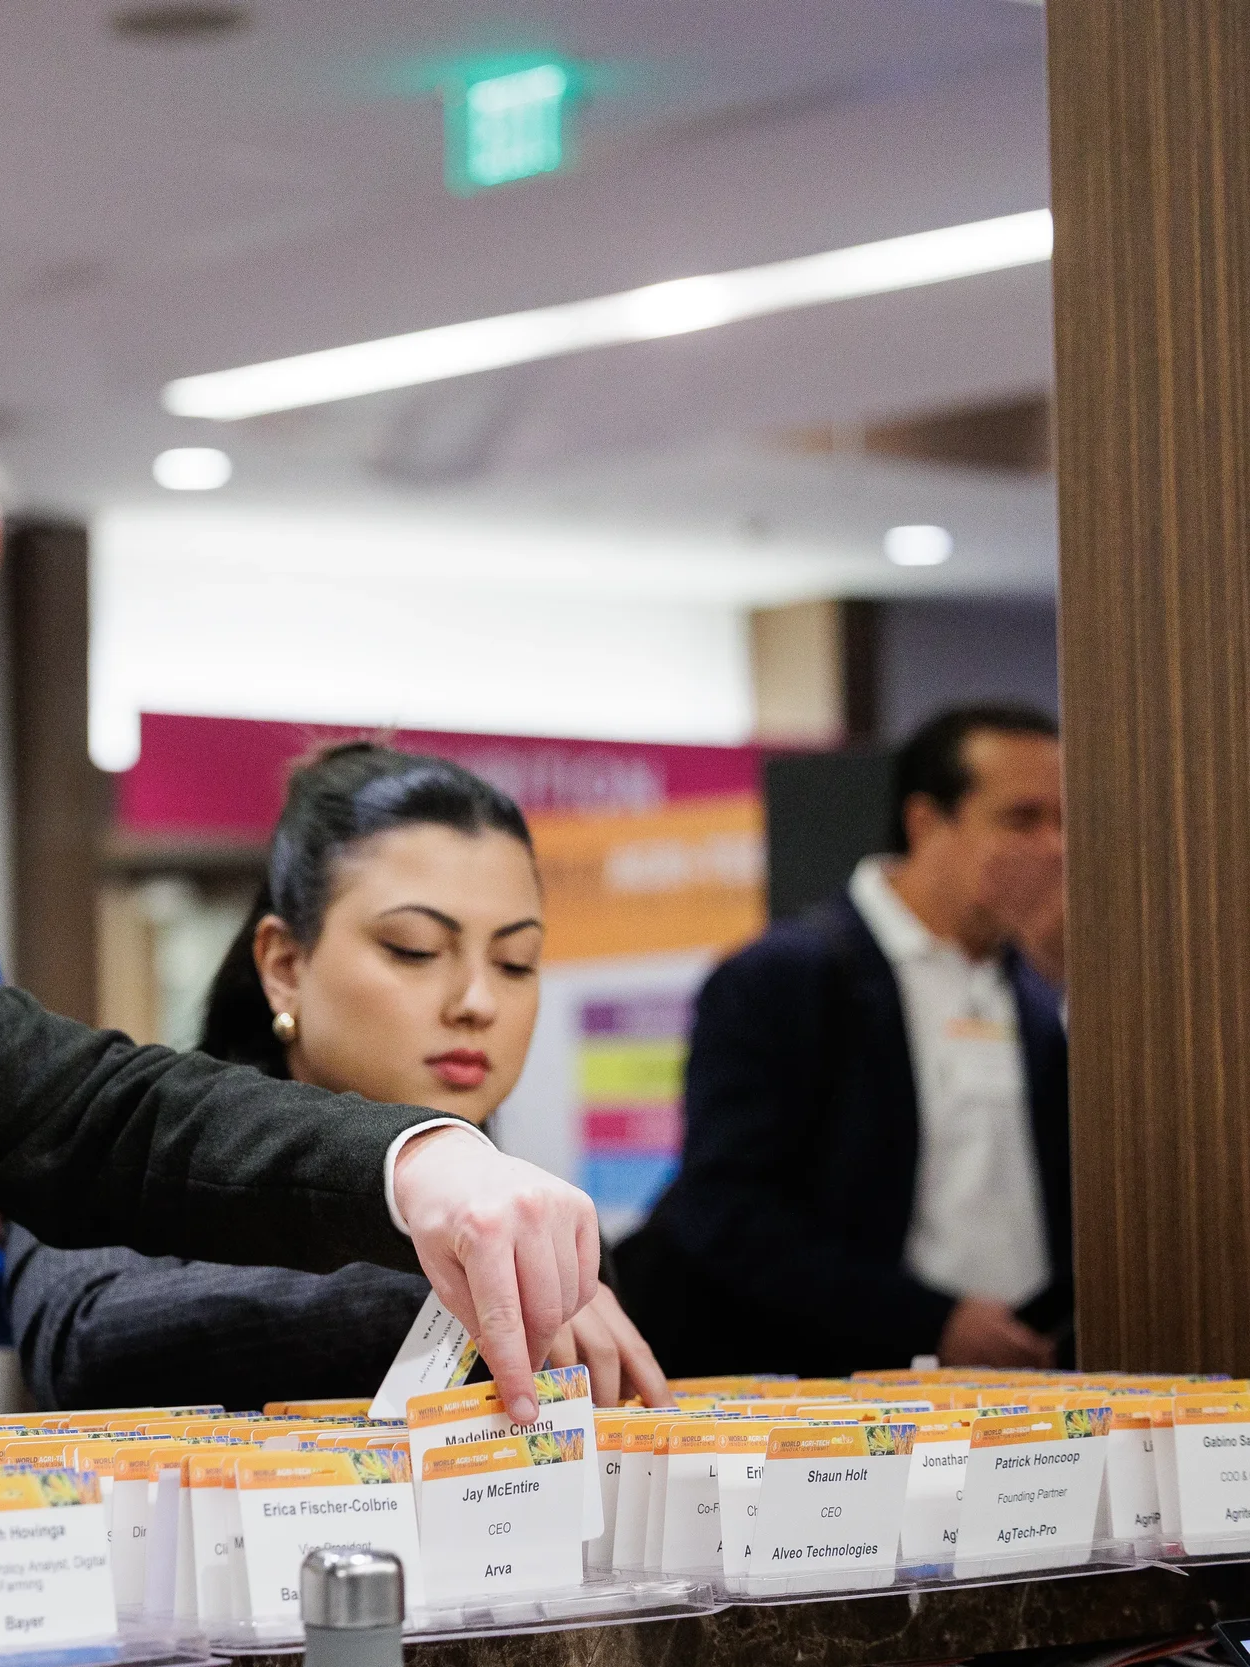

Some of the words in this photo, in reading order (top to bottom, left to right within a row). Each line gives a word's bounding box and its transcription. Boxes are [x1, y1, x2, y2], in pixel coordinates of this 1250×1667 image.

[418, 1405, 443, 1416] WORLD
[443, 1398, 480, 1411] AGRI-TECH
[445, 1428, 506, 1445] Madeline
[801, 1439, 830, 1447] AGRI-TECH
[1203, 1435, 1237, 1448] Gabino
[433, 1459, 455, 1467] WORLD
[455, 1453, 489, 1464] AGRI-TECH
[995, 1454, 1031, 1470] Patrick
[1034, 1452, 1080, 1468] Honcoop
[807, 1470, 842, 1483] Shaun
[844, 1468, 868, 1481] Holt
[462, 1488, 483, 1503] Jay
[487, 1480, 540, 1498] McEntire
[997, 1491, 1035, 1504] Founding
[1037, 1487, 1068, 1500] Partner
[263, 1501, 296, 1517] Erica
[300, 1497, 398, 1515] Fischer-Colbrie
[820, 1506, 842, 1518] CEO
[9, 1523, 67, 1542] Hovinga
[488, 1521, 512, 1536] CEO
[997, 1524, 1057, 1544] AgTech-Pro
[772, 1547, 803, 1560] Alveo
[806, 1543, 878, 1560] Technologies
[28, 1556, 69, 1574] Analyst,
[73, 1553, 107, 1570] Digital
[484, 1563, 512, 1577] Arva
[0, 1577, 45, 1595] Farming
[4, 1614, 46, 1633] Bayer
